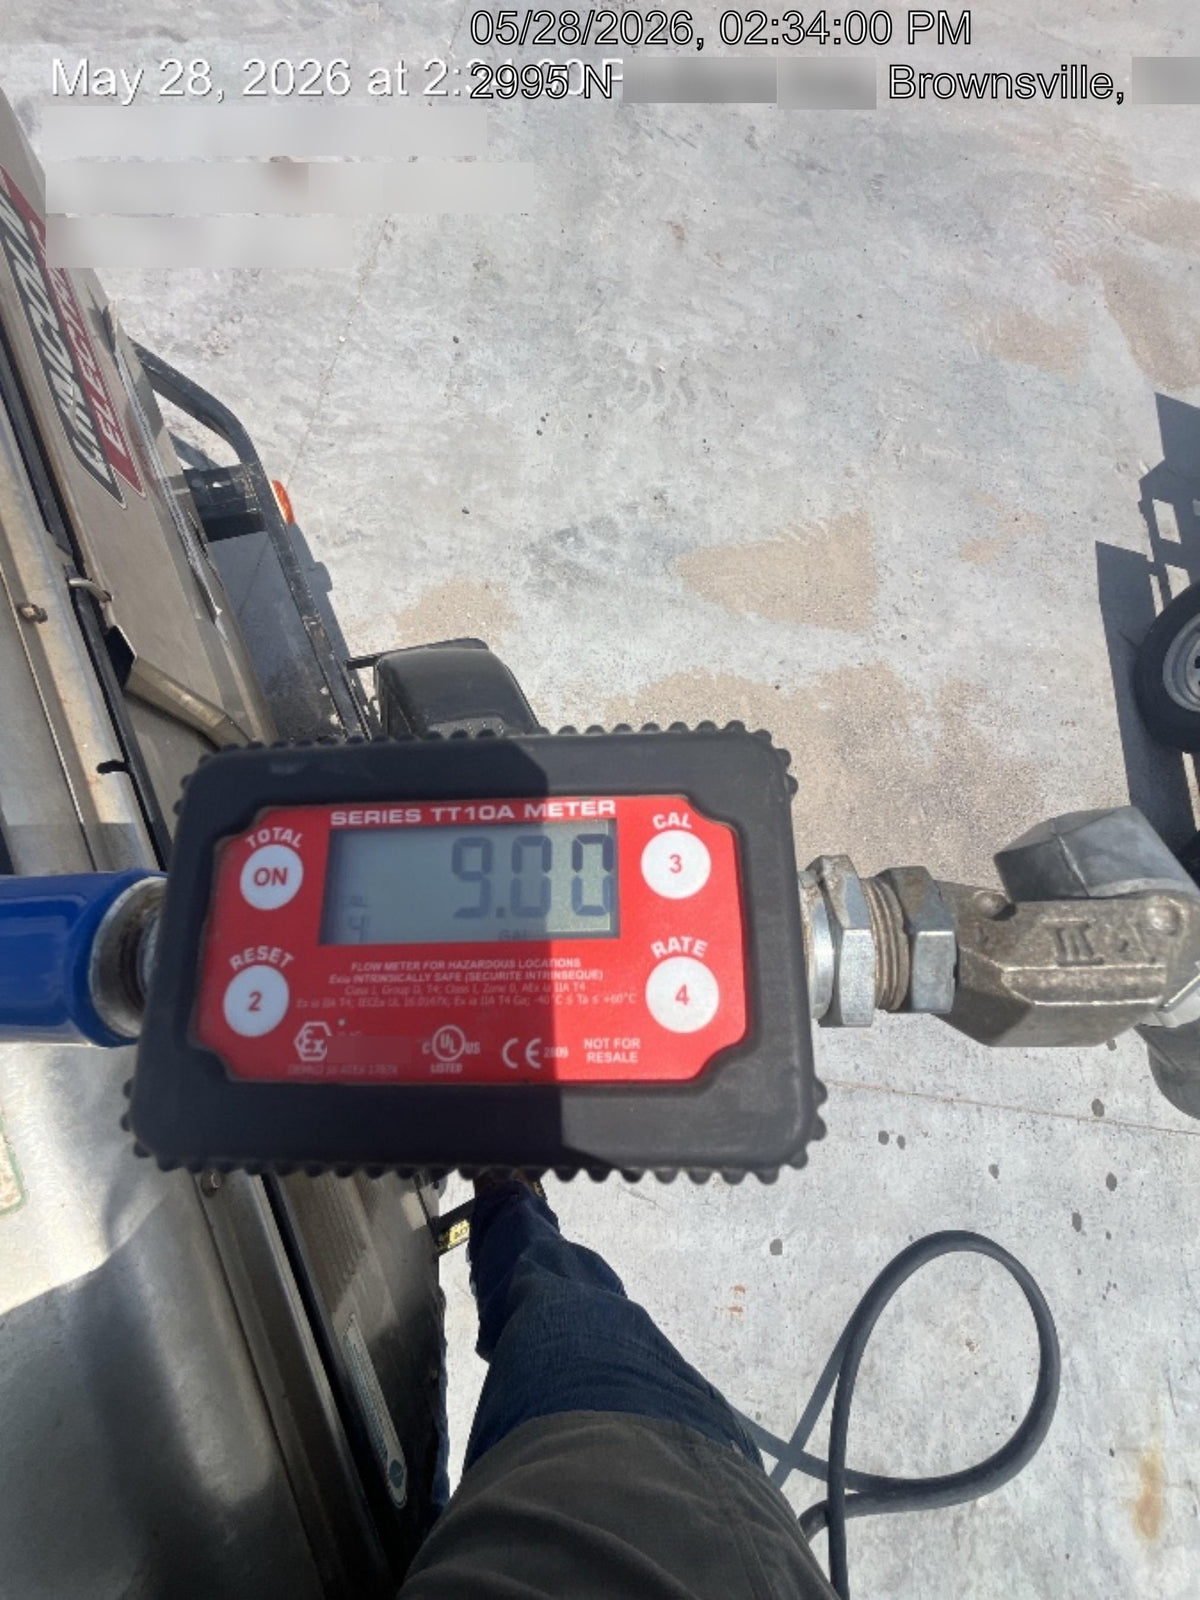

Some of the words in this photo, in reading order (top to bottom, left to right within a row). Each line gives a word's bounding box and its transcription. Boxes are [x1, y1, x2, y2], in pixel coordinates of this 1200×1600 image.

[29, 219, 129, 458] ELECTR
[331, 808, 421, 826] SERIES
[431, 804, 515, 822] TT10A
[524, 799, 616, 818] METER
[652, 812, 692, 829] CAL
[245, 826, 304, 849] TOTAL
[669, 854, 682, 874] 3
[253, 866, 288, 886] ON
[452, 833, 614, 920] 9.00
[650, 935, 708, 959] RATE
[229, 946, 294, 971] RESET
[351, 961, 382, 972] FLOW
[384, 960, 420, 971] METER
[423, 960, 446, 970] FOR
[448, 959, 515, 970] HAZARDOUS
[519, 957, 581, 969] LOCATIONS
[352, 972, 431, 983] INTRINSICALLY
[434, 971, 462, 982] SAFE
[247, 991, 262, 1012] 2
[675, 984, 691, 1006] 4
[584, 1038, 609, 1050] NOT
[613, 1037, 641, 1049] FOR
[586, 1050, 639, 1064] RESALE
[430, 1063, 462, 1075] LISTED
